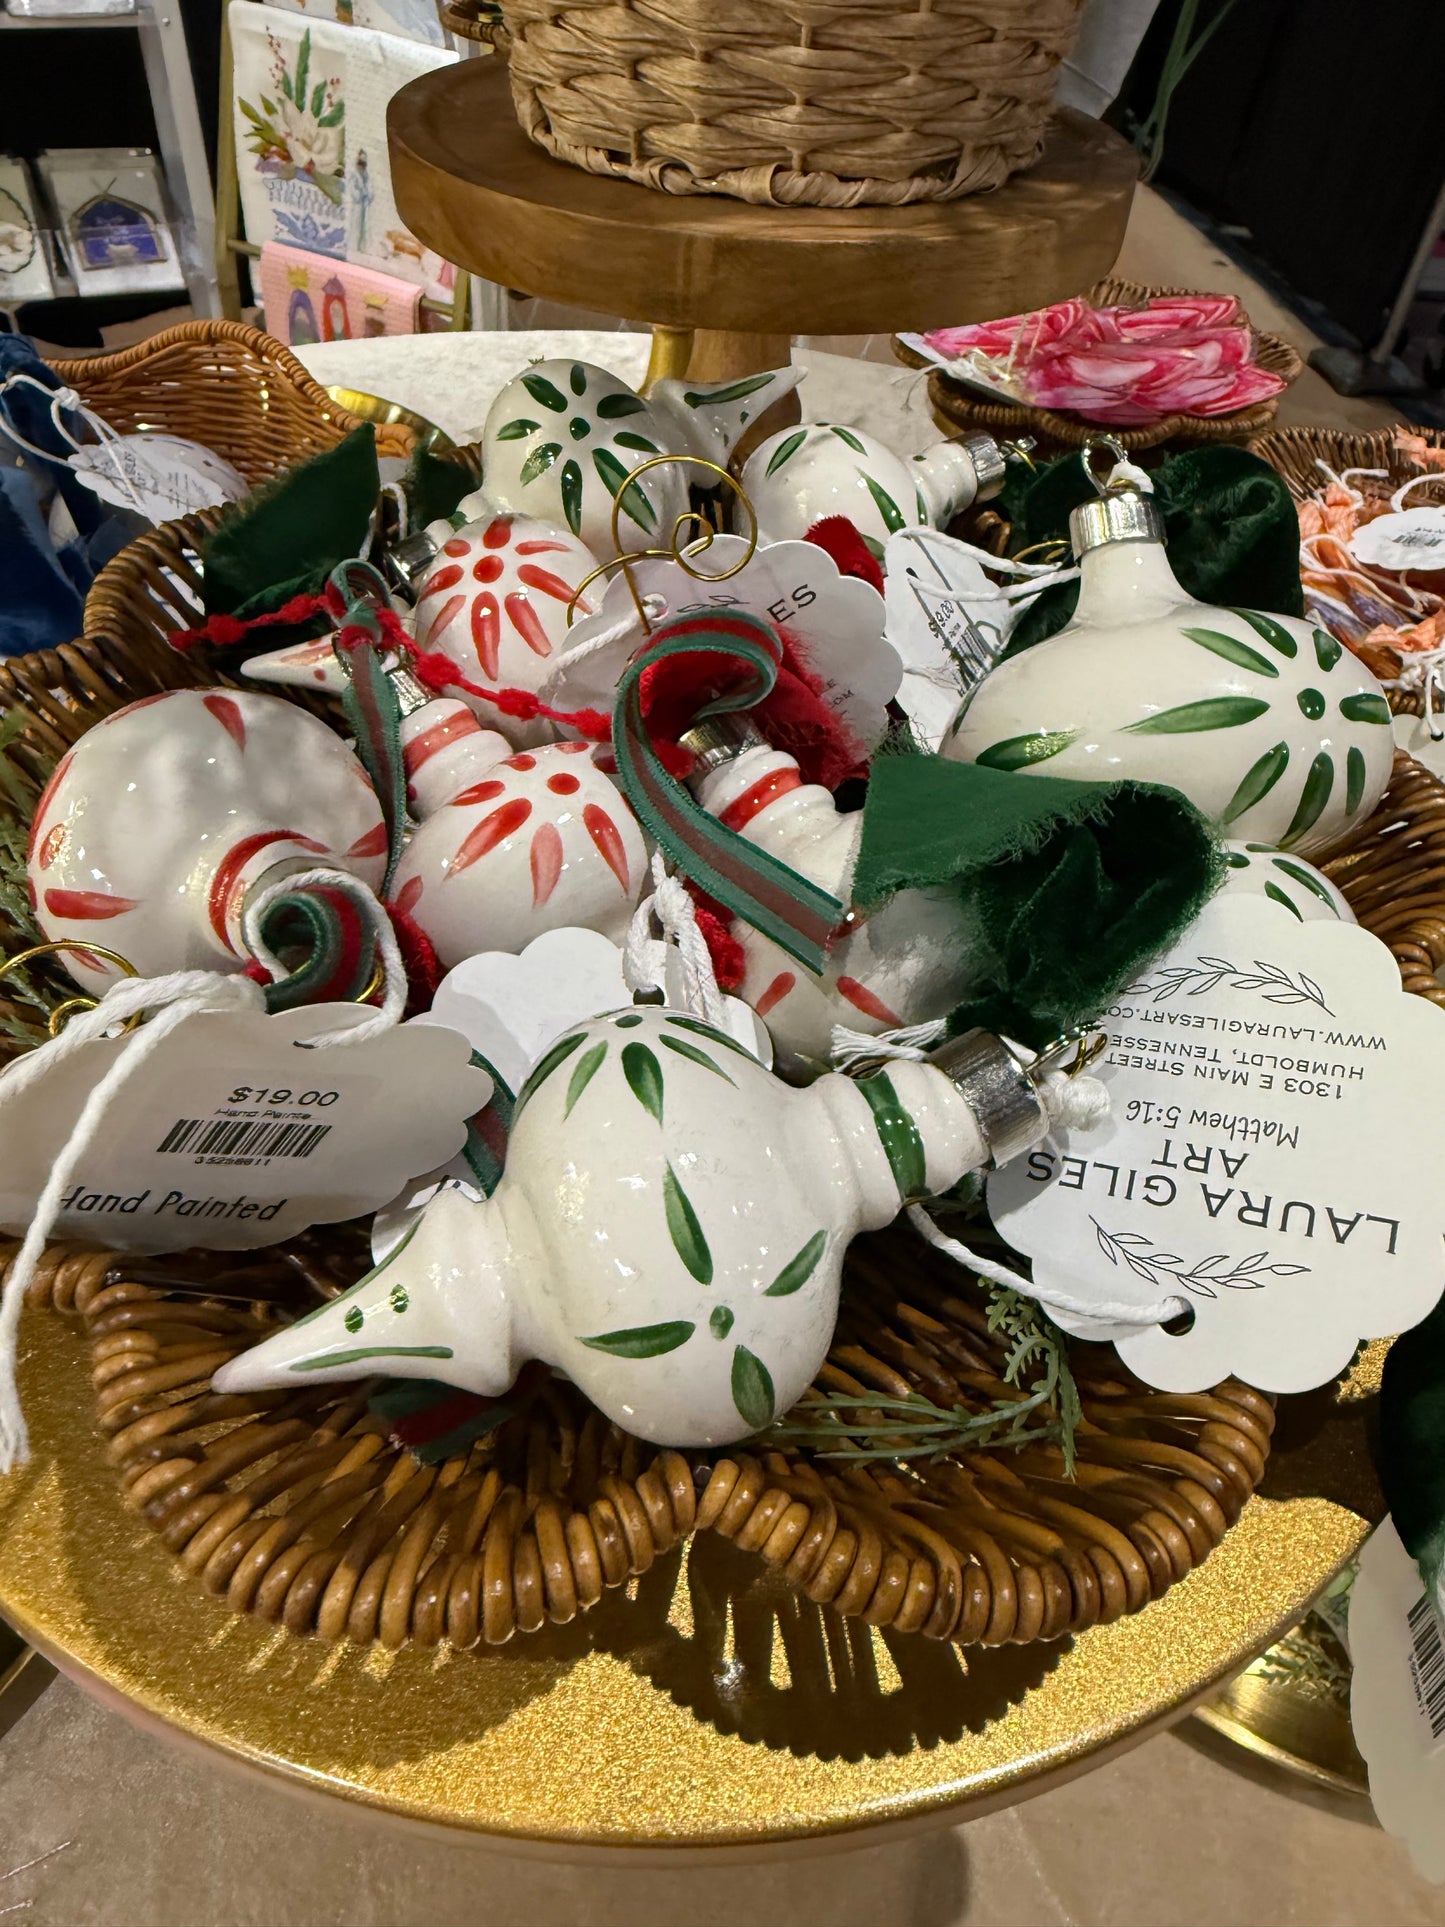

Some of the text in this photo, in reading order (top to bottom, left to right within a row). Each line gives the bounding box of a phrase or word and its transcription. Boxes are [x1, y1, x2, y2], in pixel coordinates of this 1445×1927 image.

[1107, 1004, 1387, 1051] WWW.LAURAGILESART.CO
[1105, 1053, 1342, 1099] 1303 E MAIN STREET
[1109, 1034, 1364, 1081] HUMBOLDT, TENNESSE
[227, 1086, 339, 1107] $19.00
[1126, 1100, 1299, 1149] Matthew 5:16
[1151, 1139, 1249, 1179] ART
[153, 1190, 288, 1221] Painted
[1027, 1150, 1400, 1255] LAURA GILES
